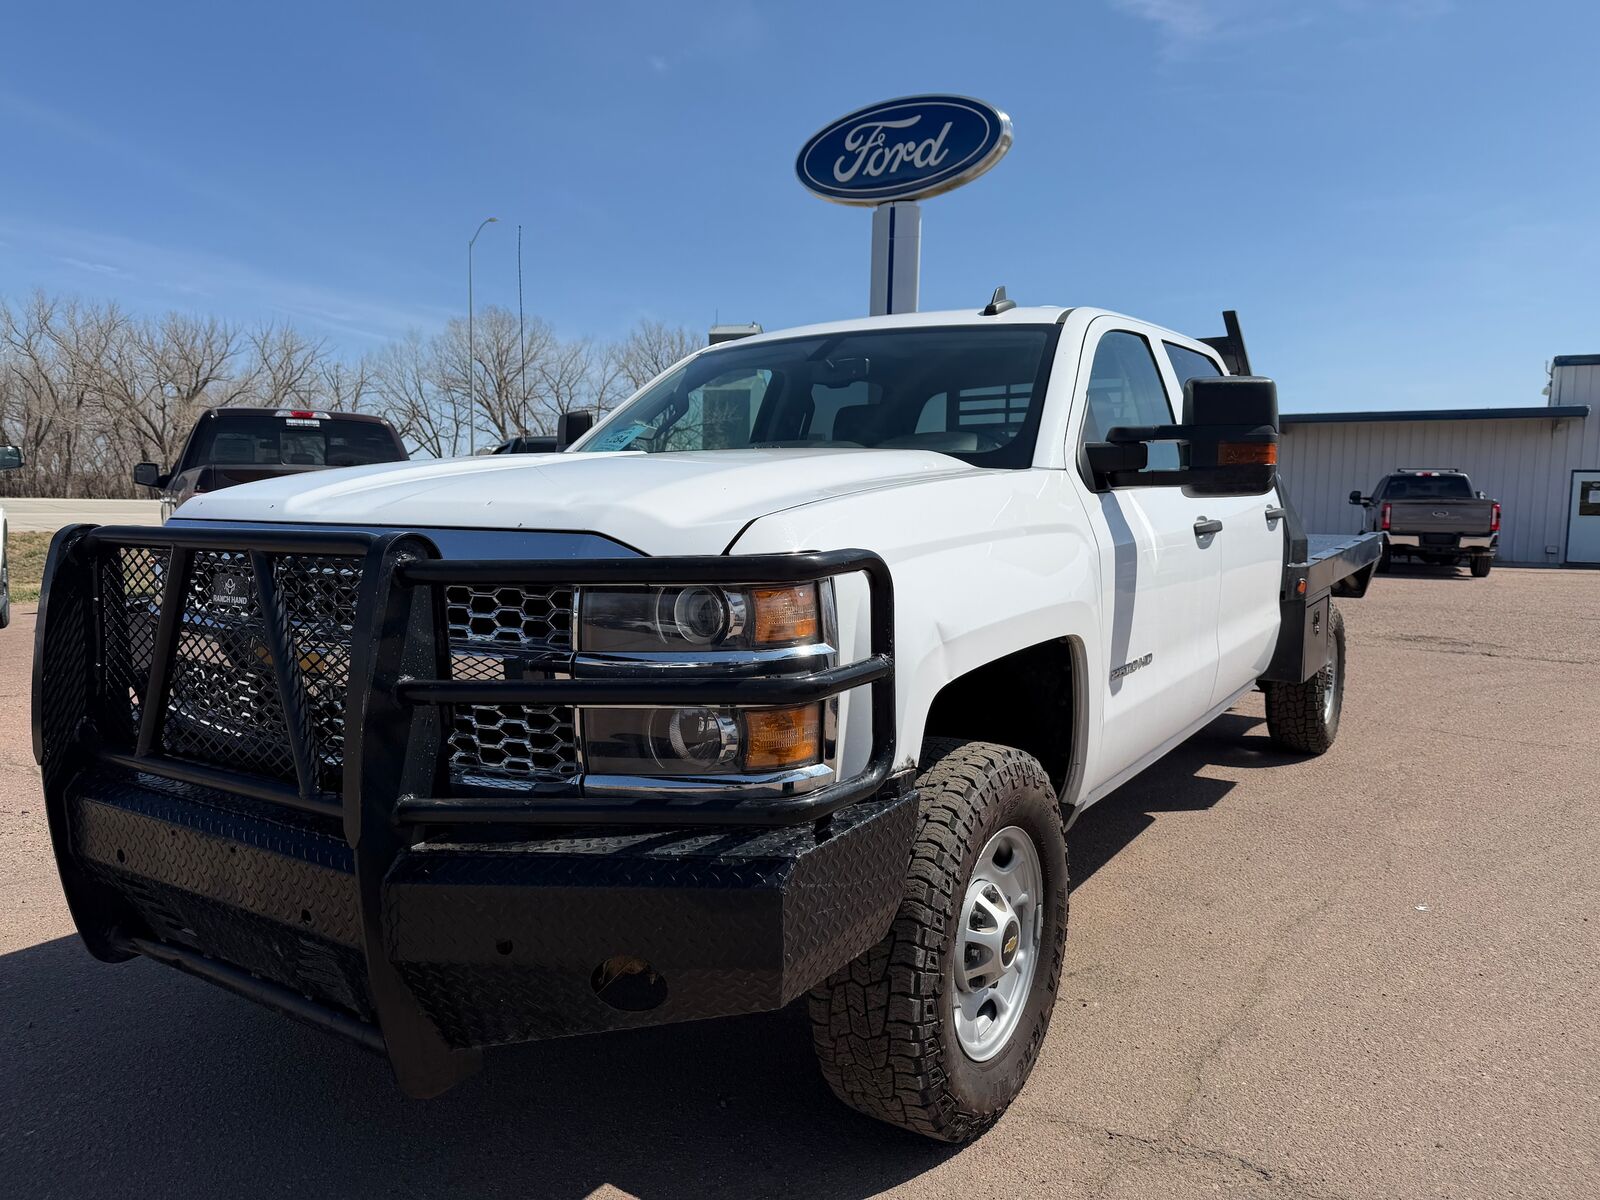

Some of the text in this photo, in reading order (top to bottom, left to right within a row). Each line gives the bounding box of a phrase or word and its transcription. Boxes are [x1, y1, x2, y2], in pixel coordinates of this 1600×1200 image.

[833, 114, 953, 183] Ford
[213, 594, 248, 604] RANCH HAND
